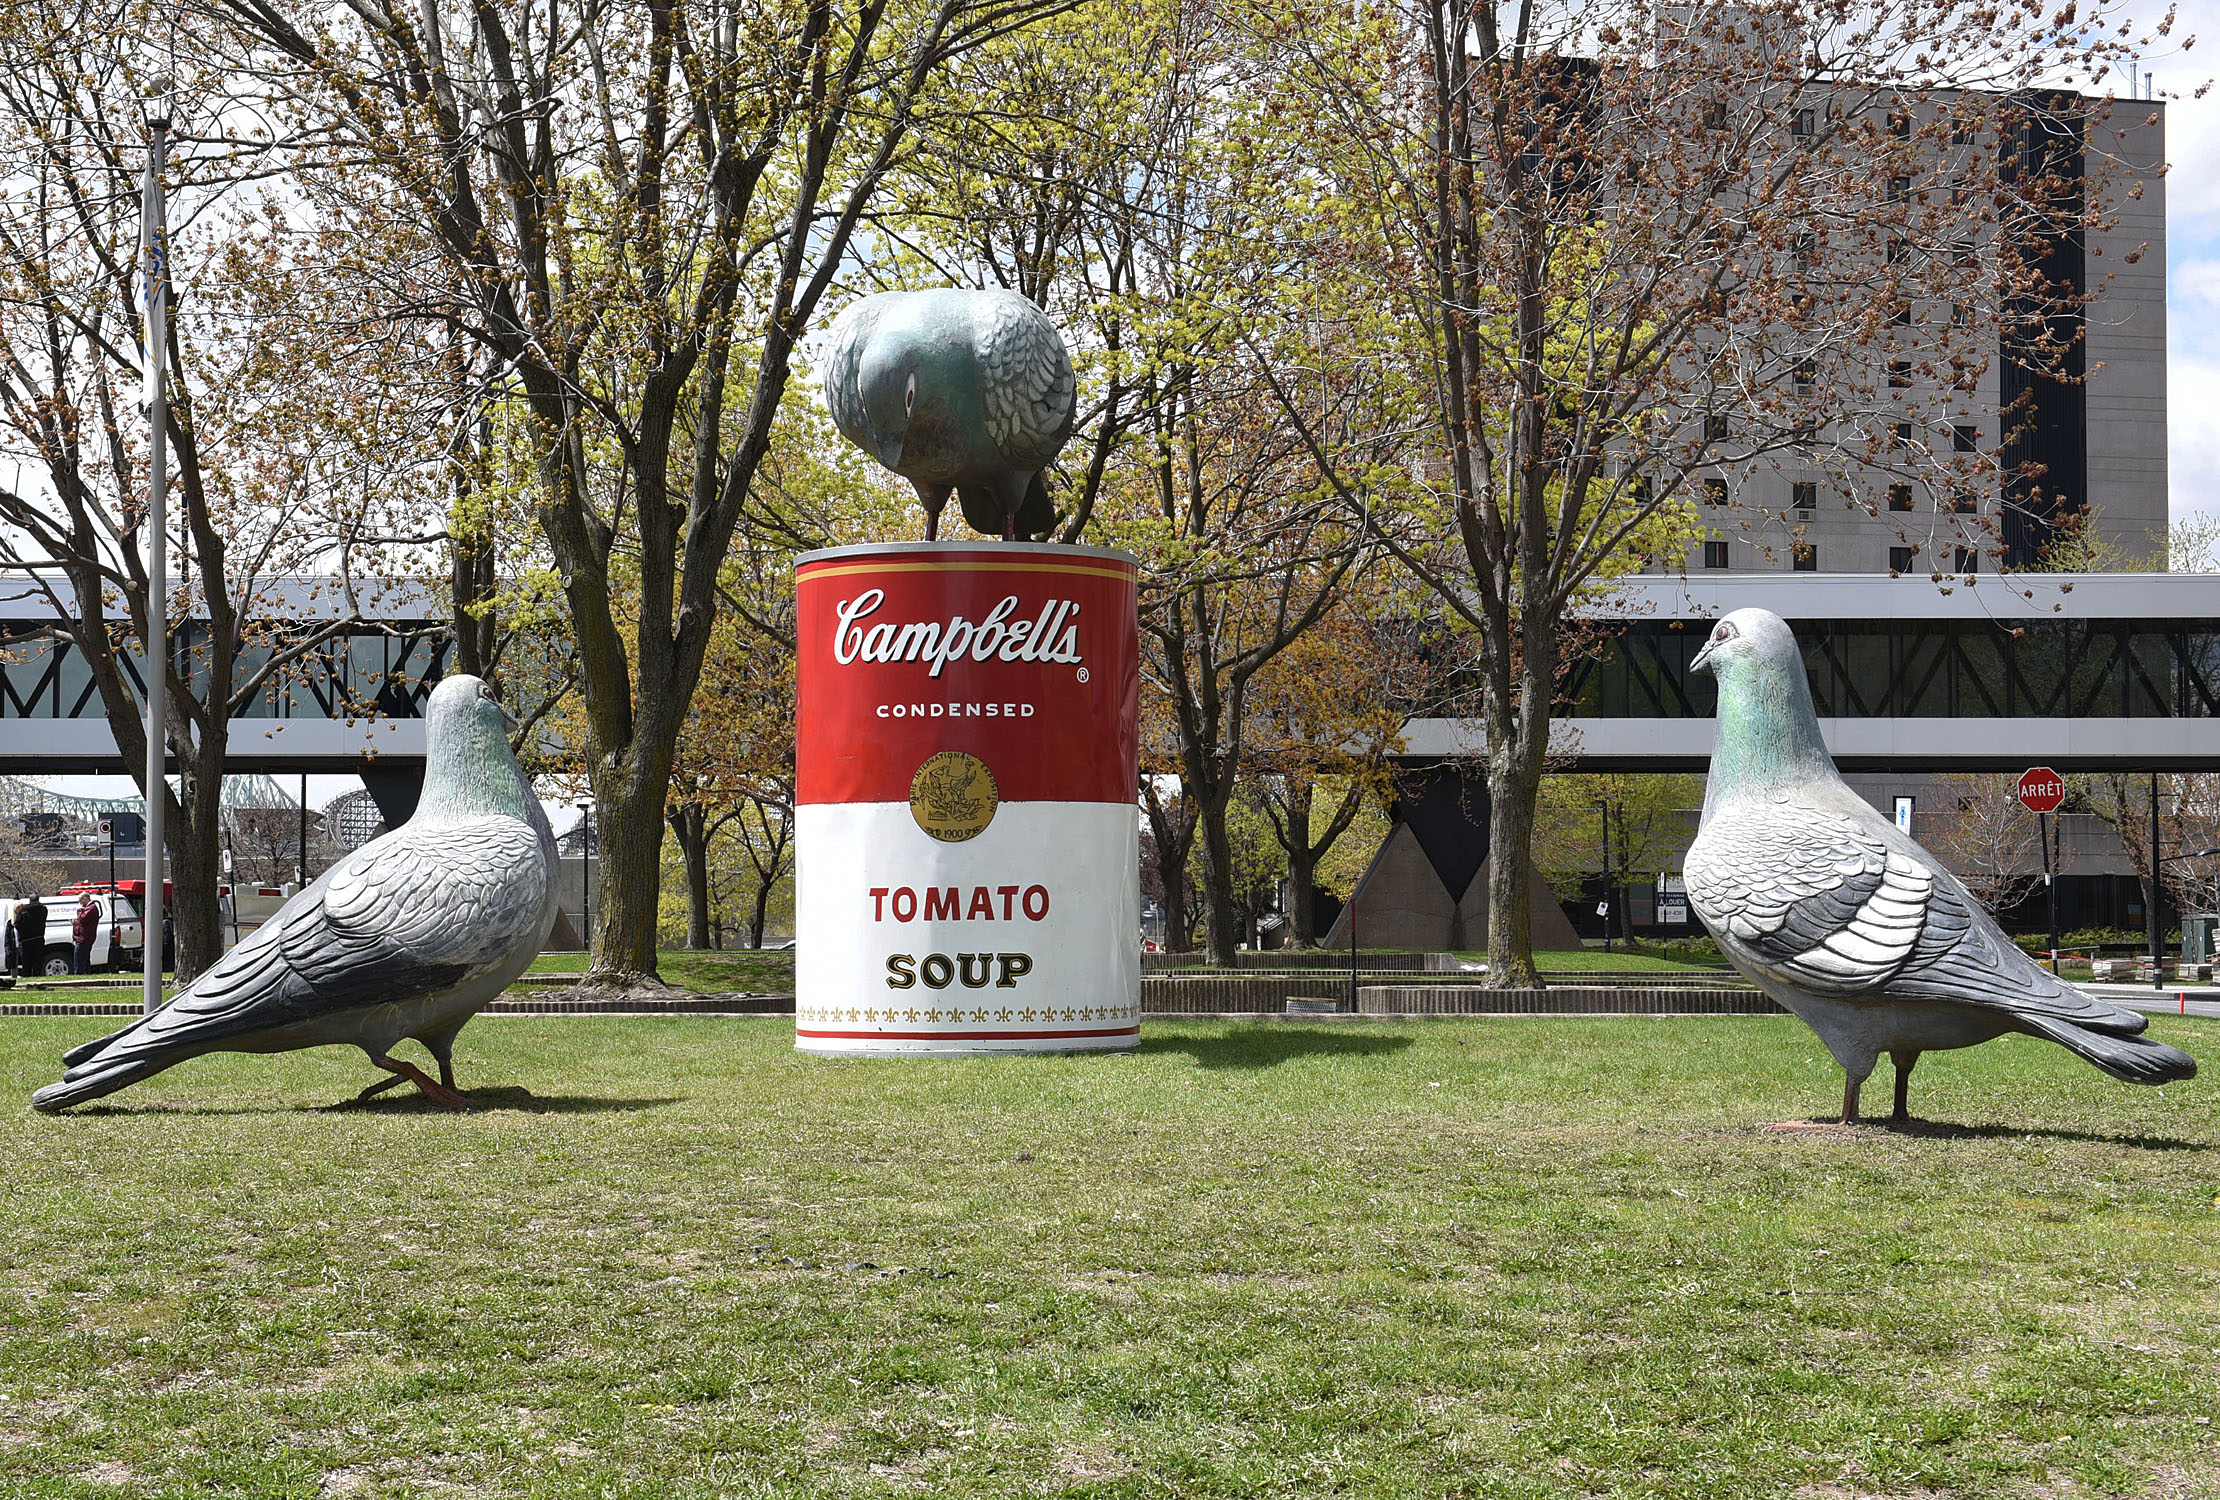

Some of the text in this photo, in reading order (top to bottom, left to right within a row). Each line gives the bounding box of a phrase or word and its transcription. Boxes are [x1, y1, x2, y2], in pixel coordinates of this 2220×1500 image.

[834, 588, 1082, 677] Campbell's
[876, 703, 1035, 718] CONDENSED
[909, 752, 998, 813] PARIS INTERNATIONAL EXPOSITION
[2021, 780, 2062, 797] ARRÊT
[944, 828, 964, 839] 1900
[869, 884, 1050, 923] TOMATO
[886, 953, 1033, 989] SOUP
